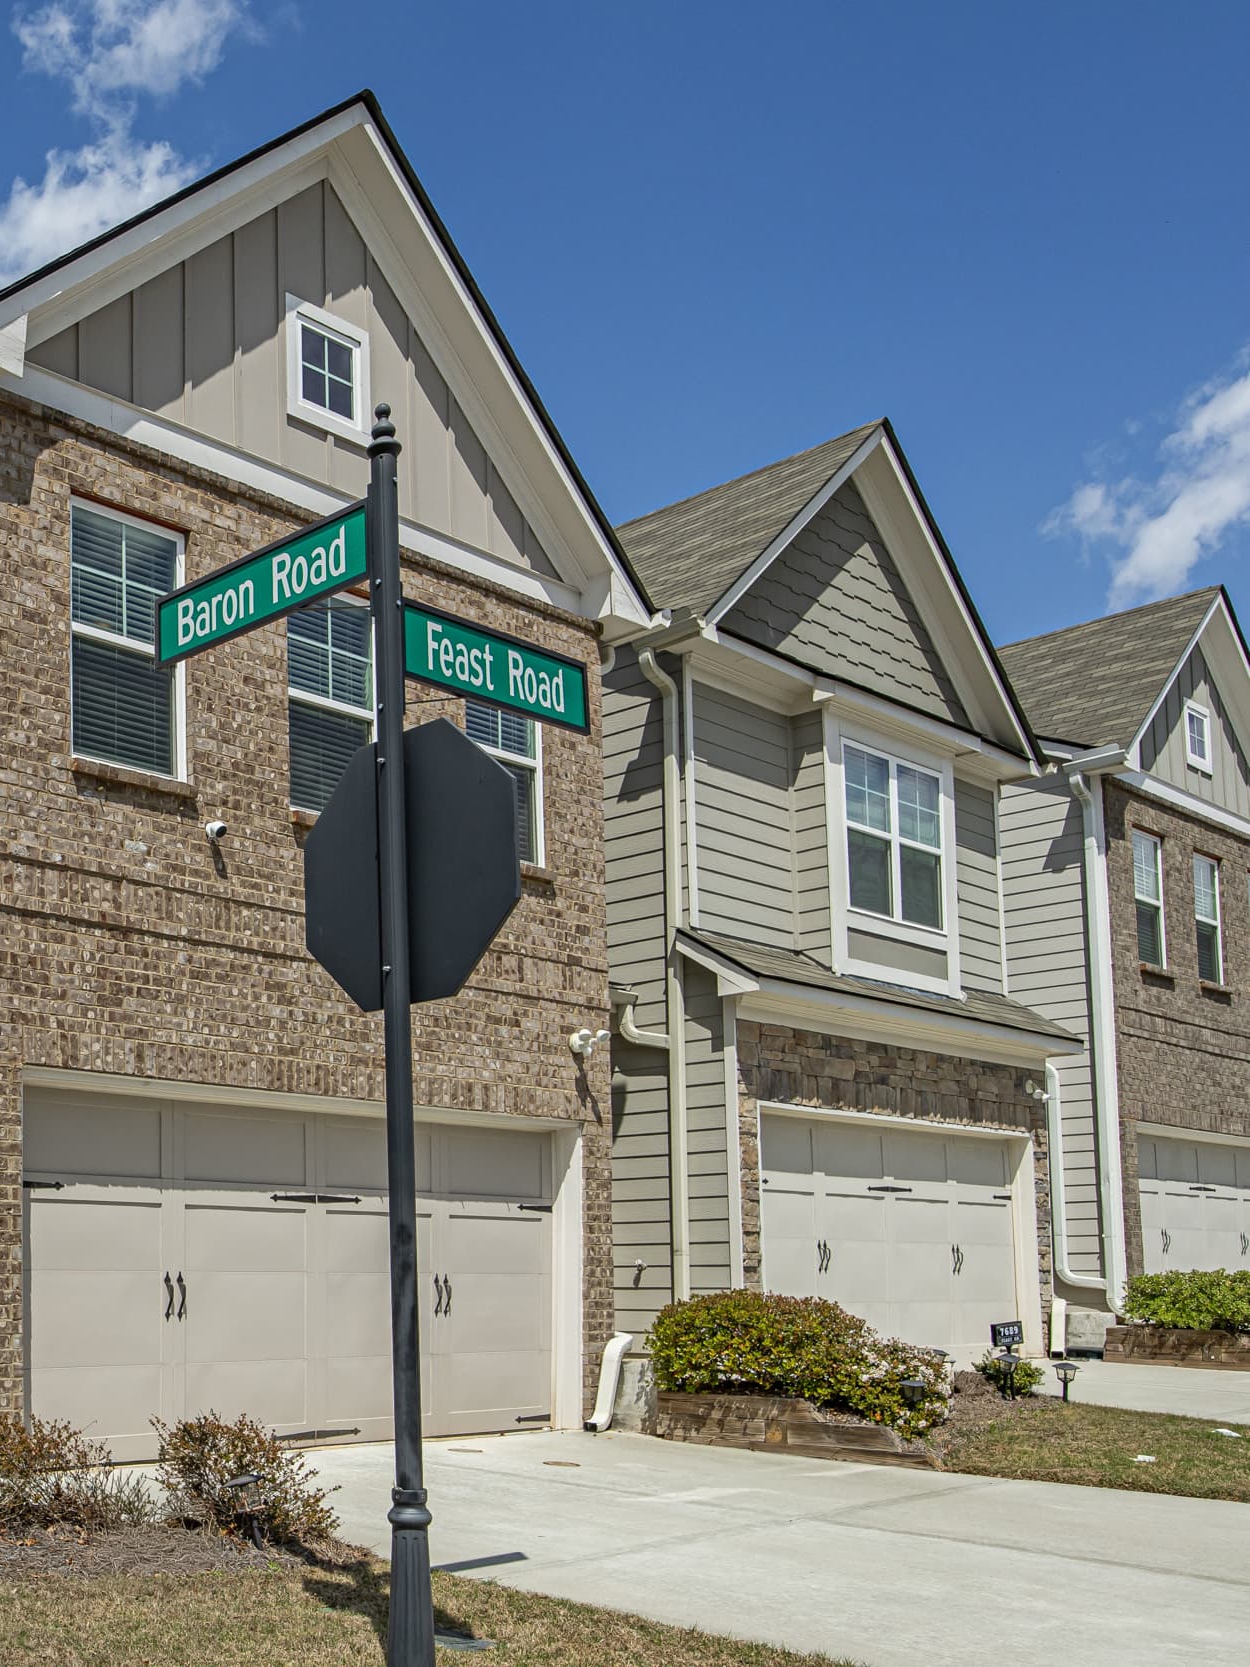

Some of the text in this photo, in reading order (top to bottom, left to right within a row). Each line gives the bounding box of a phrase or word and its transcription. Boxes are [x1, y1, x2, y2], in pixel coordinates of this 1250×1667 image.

[177, 524, 347, 647] Baron Road
[427, 620, 565, 713] Feast Road
